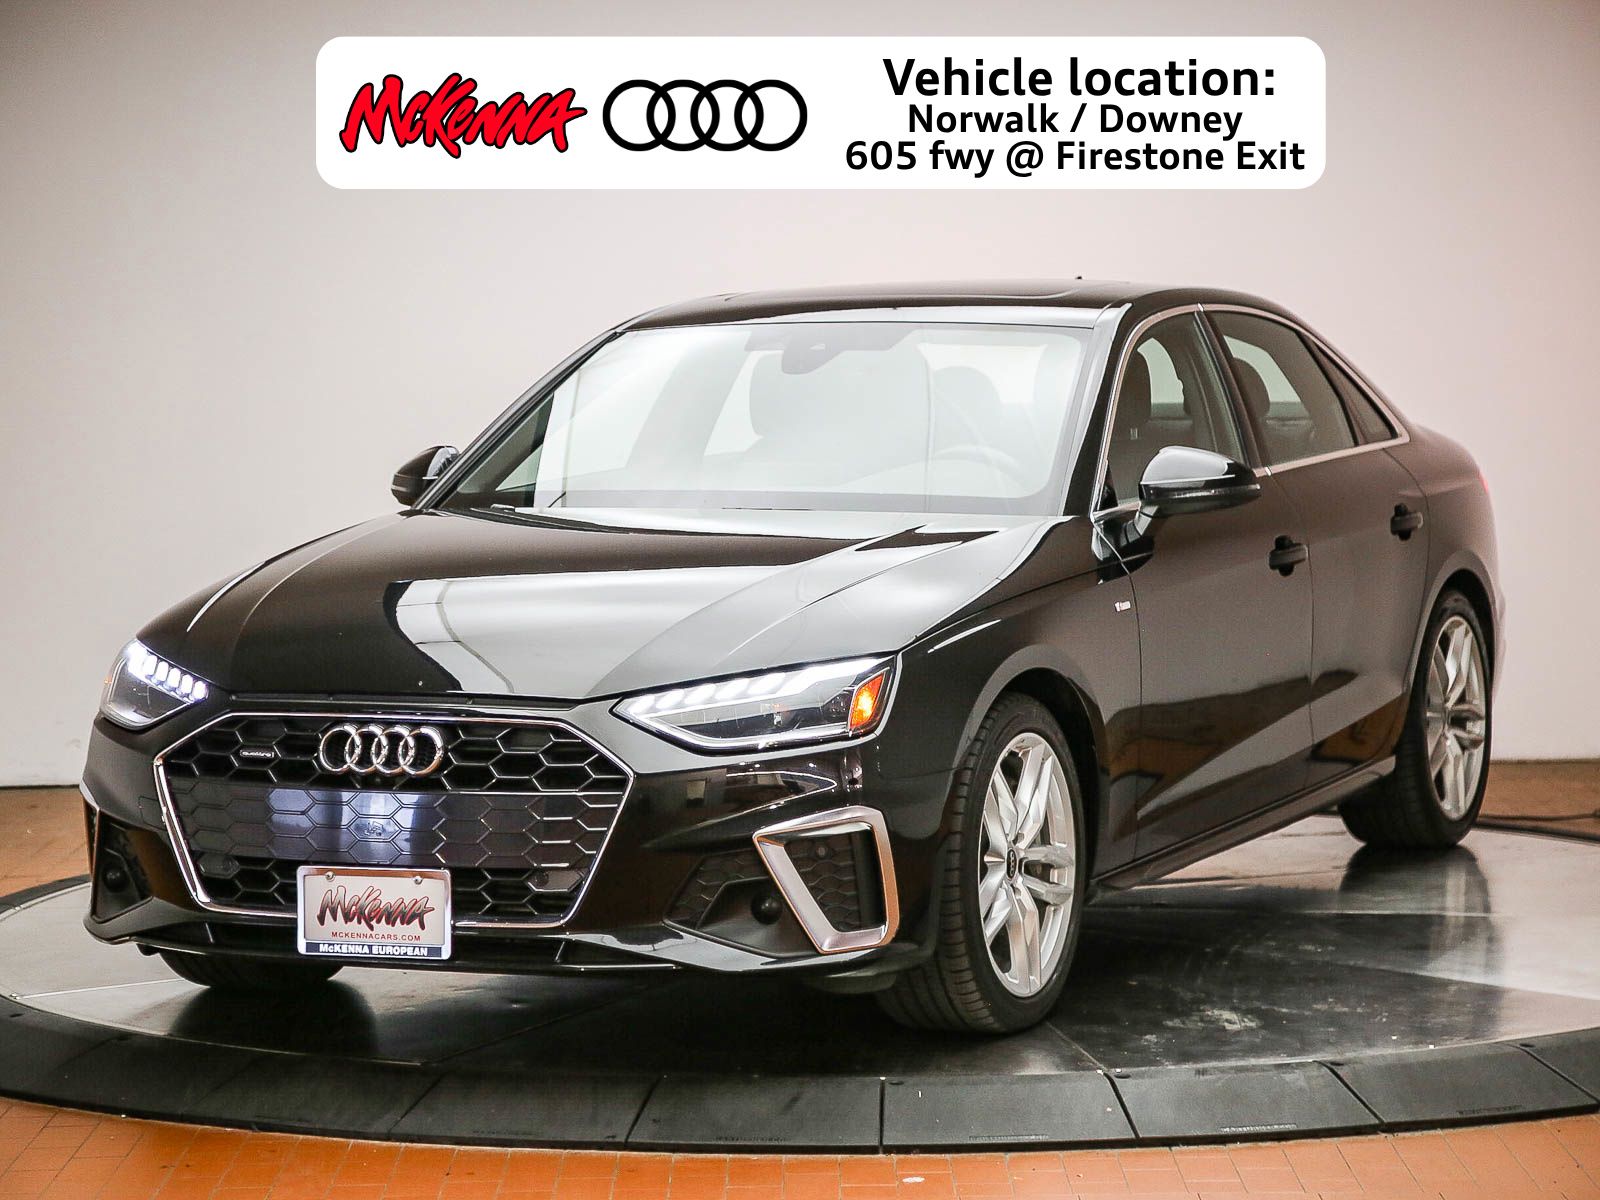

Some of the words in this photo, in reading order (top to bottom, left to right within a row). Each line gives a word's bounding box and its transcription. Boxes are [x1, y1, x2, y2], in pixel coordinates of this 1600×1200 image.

[331, 931, 421, 942] MCKENNACARS.COM
[319, 944, 370, 954] McKENNA
[372, 946, 428, 956] EUROPEAN
